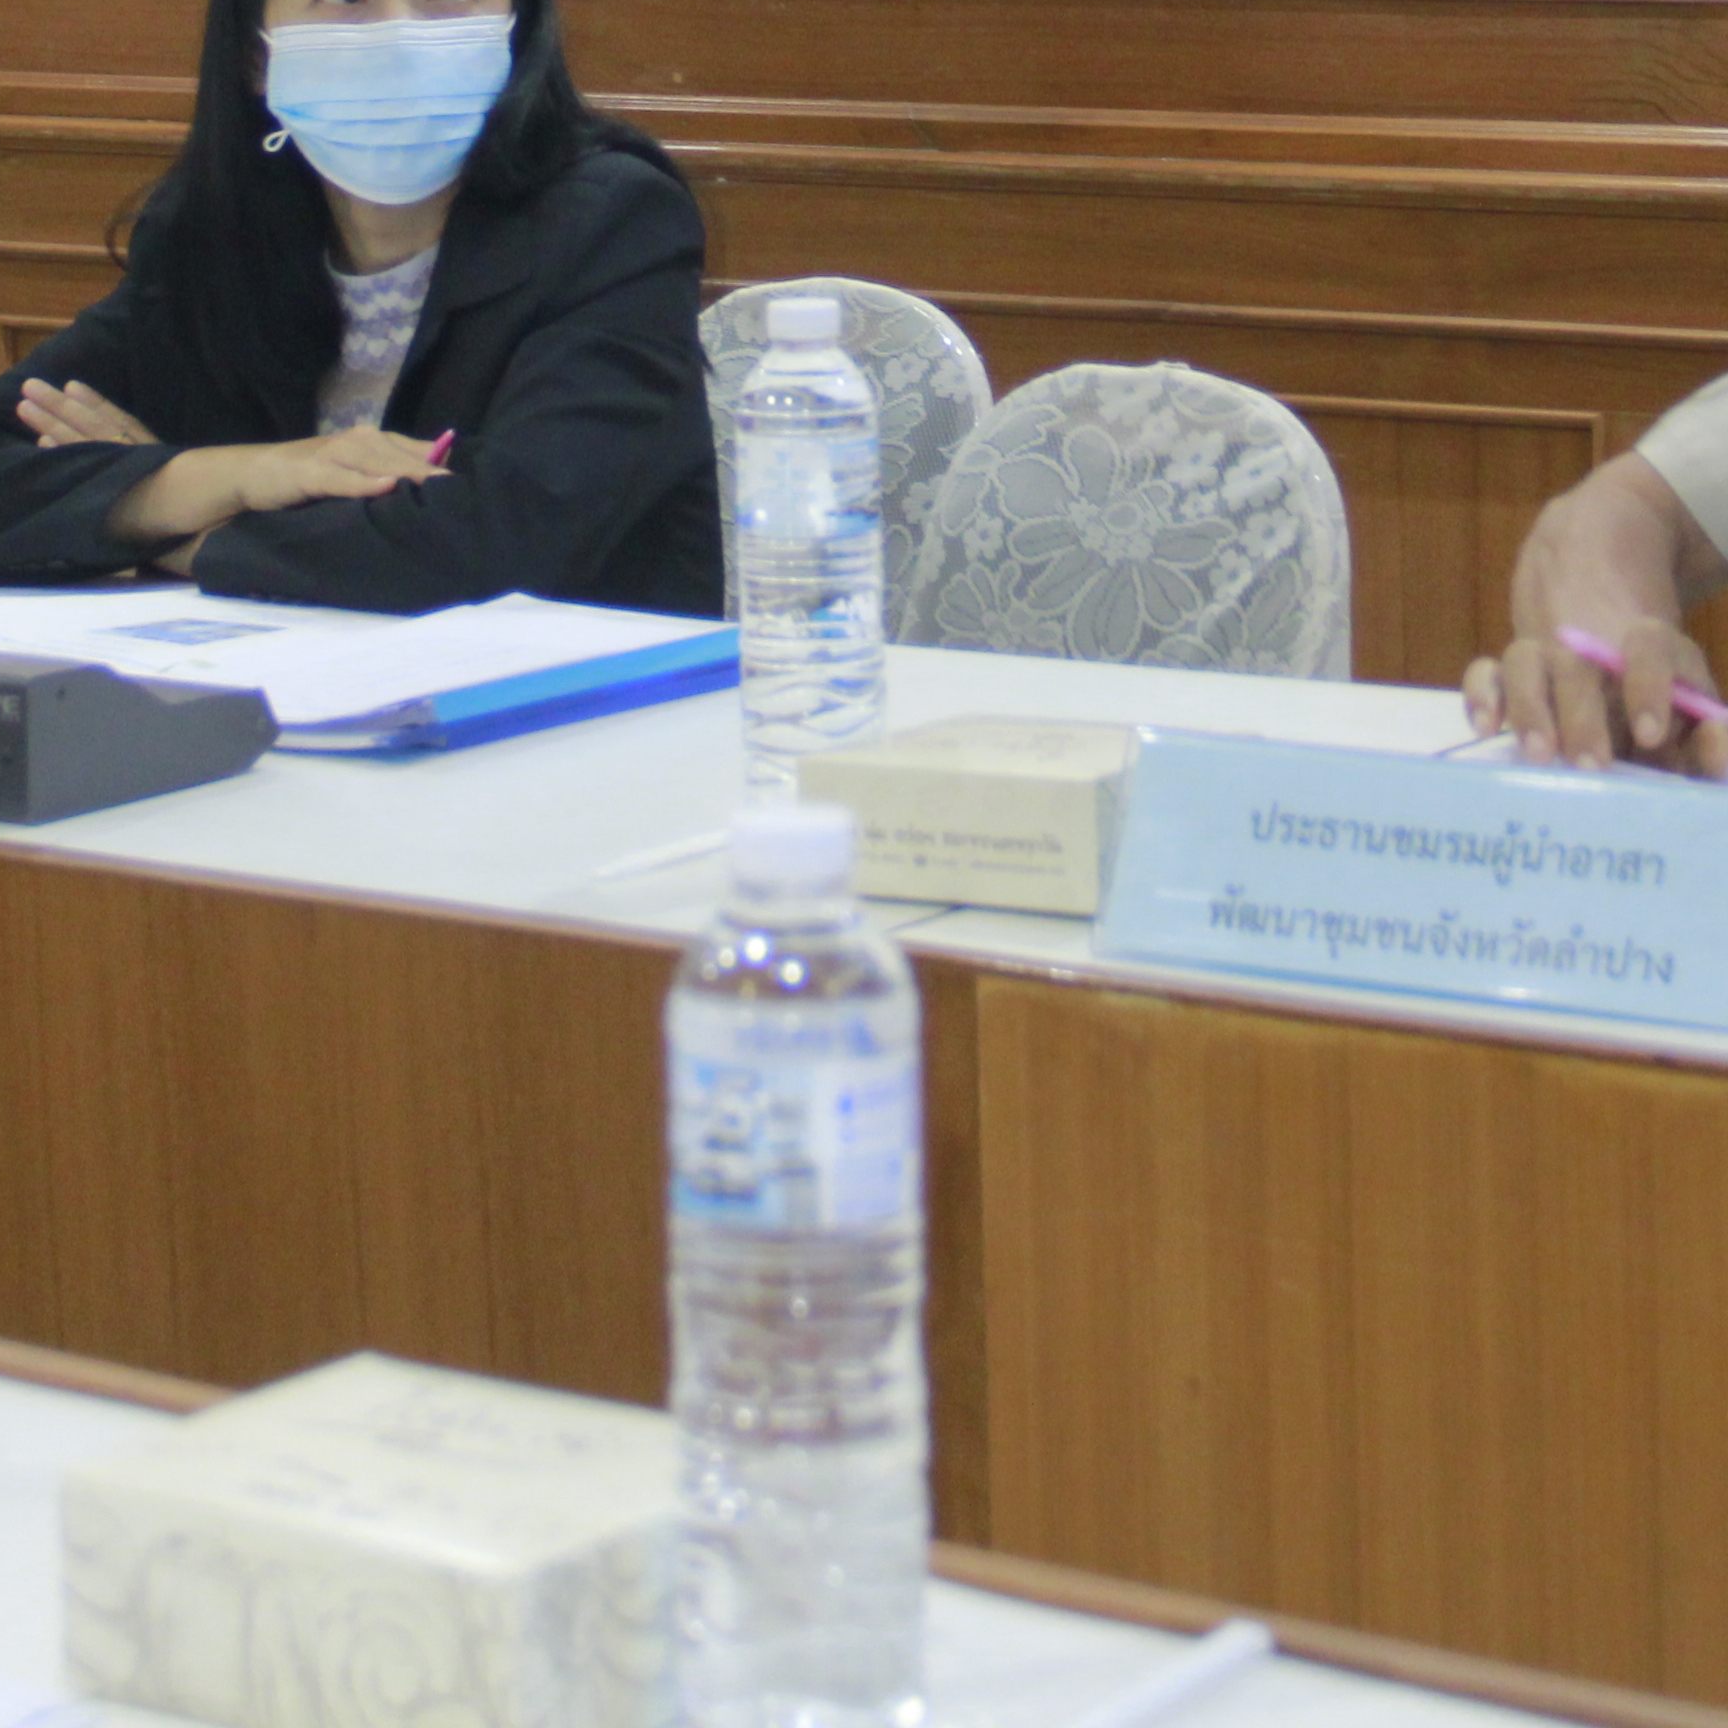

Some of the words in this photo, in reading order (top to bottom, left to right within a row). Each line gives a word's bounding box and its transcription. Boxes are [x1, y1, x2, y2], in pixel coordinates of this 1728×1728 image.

[1249, 800, 1667, 888] ประธานชมรมผู้นำอาสา
[1207, 882, 1677, 985] พัฒนาชุมชนจังหวัดลำปาง
